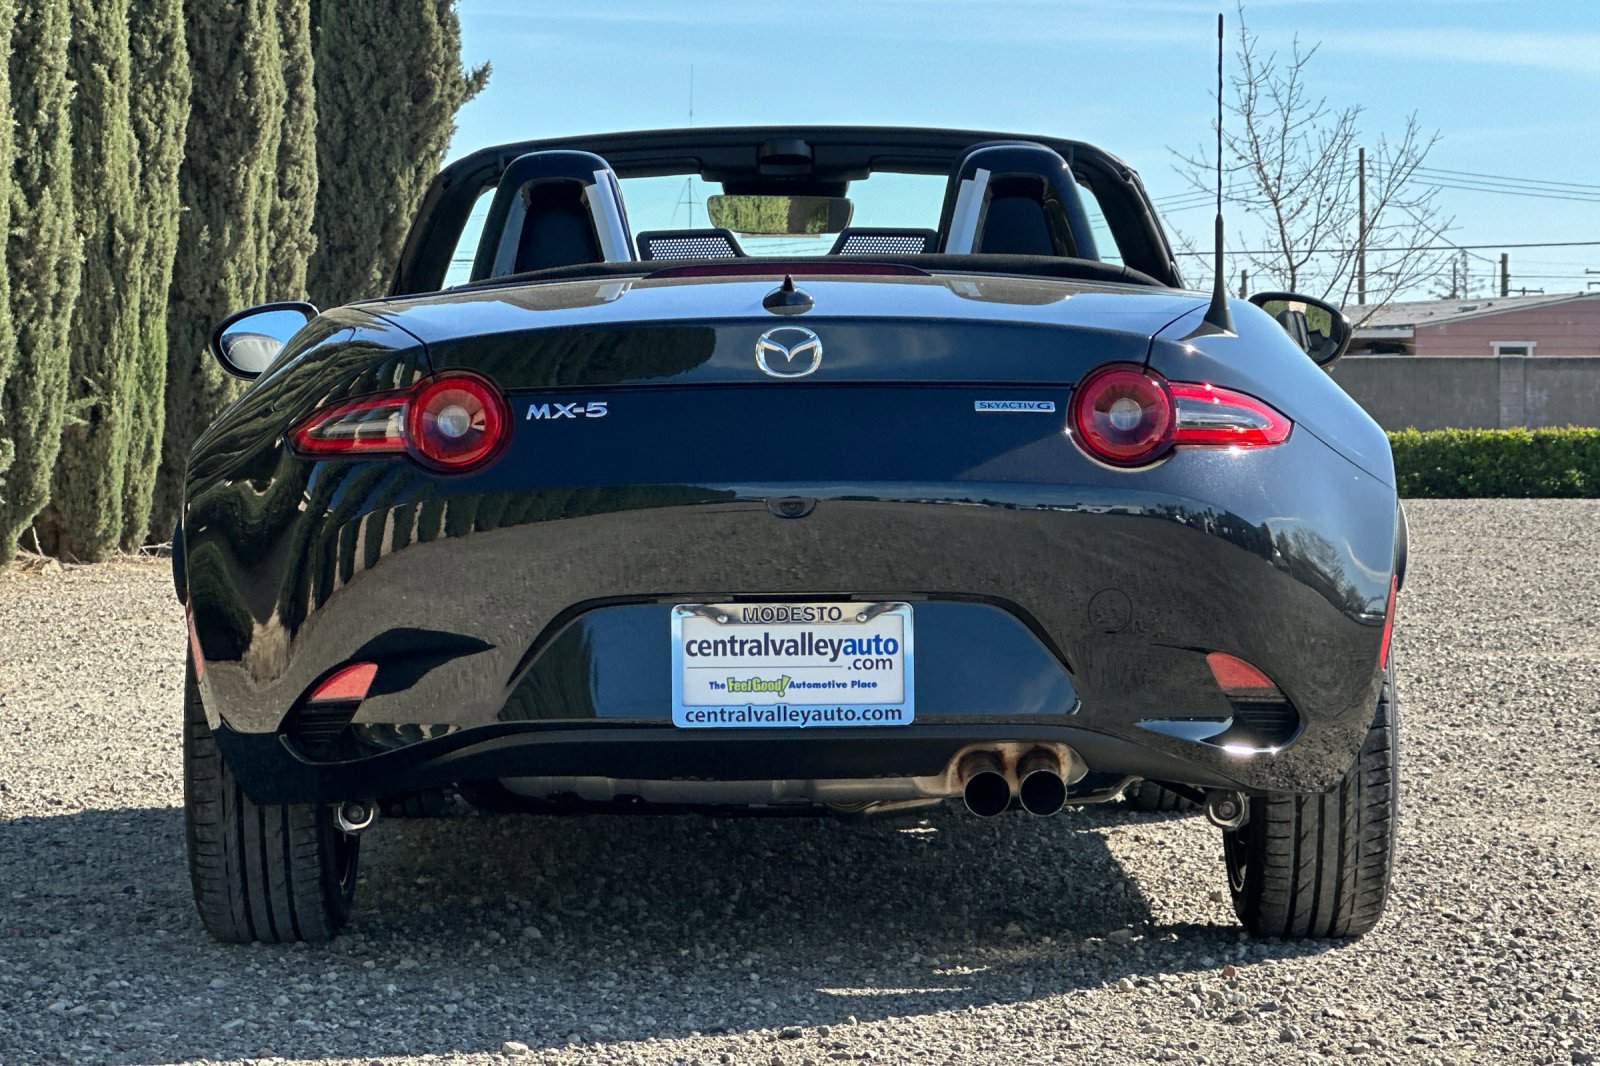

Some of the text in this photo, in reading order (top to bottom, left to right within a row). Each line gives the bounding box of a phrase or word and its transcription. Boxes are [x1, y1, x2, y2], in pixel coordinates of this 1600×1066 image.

[526, 401, 608, 420] MX-5
[742, 606, 843, 623] MODESTO
[685, 632, 899, 662] centralvalleyauto
[847, 658, 893, 670] .com
[709, 681, 726, 690] The
[788, 680, 848, 689] Automotive
[850, 680, 878, 689] Place
[685, 705, 902, 726] centralvalleyauto.com
